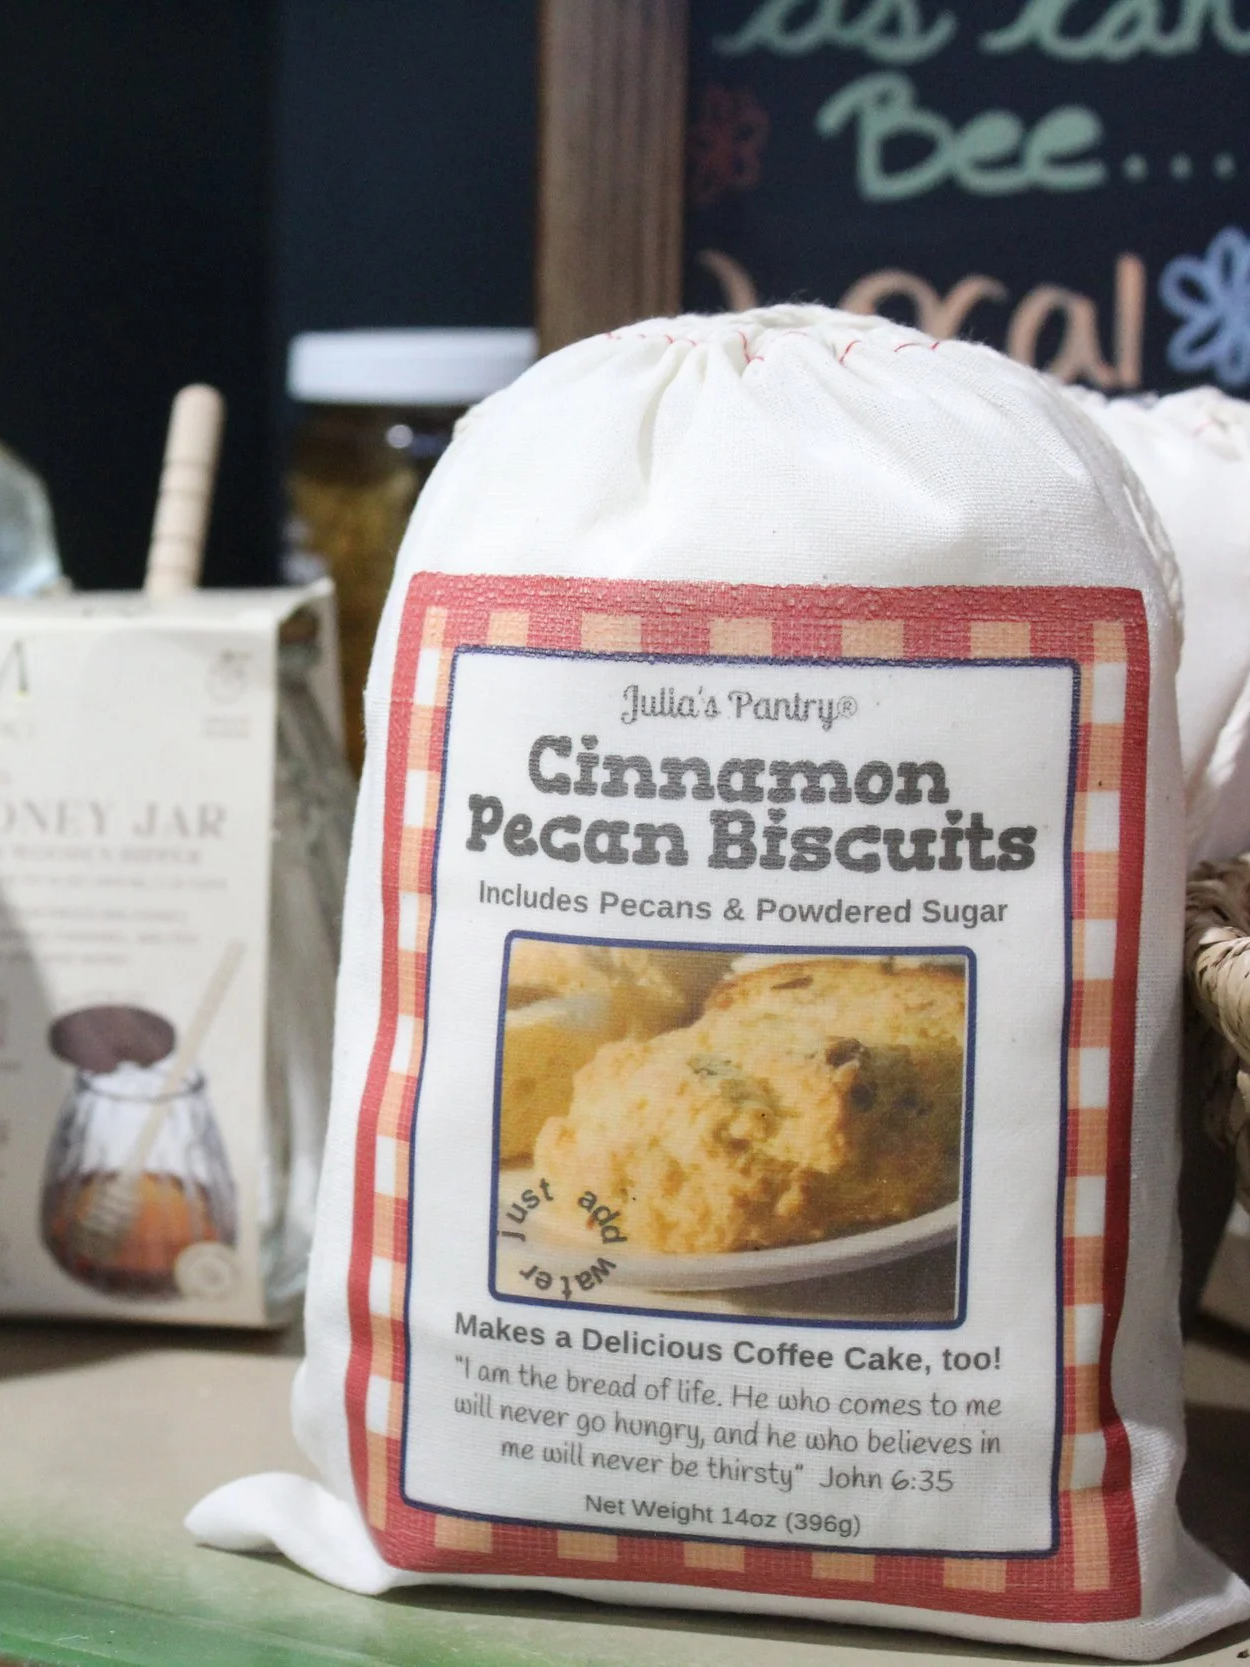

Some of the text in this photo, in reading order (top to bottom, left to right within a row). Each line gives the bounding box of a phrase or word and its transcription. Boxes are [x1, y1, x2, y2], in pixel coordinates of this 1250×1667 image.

[621, 684, 721, 725] Julia's
[528, 734, 950, 806] Cinnamon
[131, 799, 229, 841] JAR
[465, 793, 1038, 874] Pecan Biscuits
[479, 880, 1009, 929] Includes Pecans & Powdered Sugar
[496, 1178, 628, 1301] just add water
[455, 1312, 1002, 1375] Makes a Delicious Coffee Cake, too!
[478, 1364, 510, 1385] am
[518, 1363, 558, 1390] the
[566, 1369, 637, 1399] bread
[644, 1376, 671, 1401] of
[677, 1379, 723, 1407] life.
[733, 1384, 769, 1409] He
[778, 1388, 830, 1414] who
[839, 1398, 922, 1416] comes
[930, 1391, 957, 1417] to
[966, 1398, 1002, 1416] me
[454, 1393, 1001, 1455] will never go hungry, and he who believes in
[501, 1440, 534, 1460] me
[543, 1441, 583, 1467] will
[592, 1450, 663, 1474] never
[671, 1452, 699, 1478] be
[819, 1465, 883, 1490] John
[891, 1469, 955, 1492] 6:35
[585, 1495, 862, 1538] Net Weight 14oz (396g)
